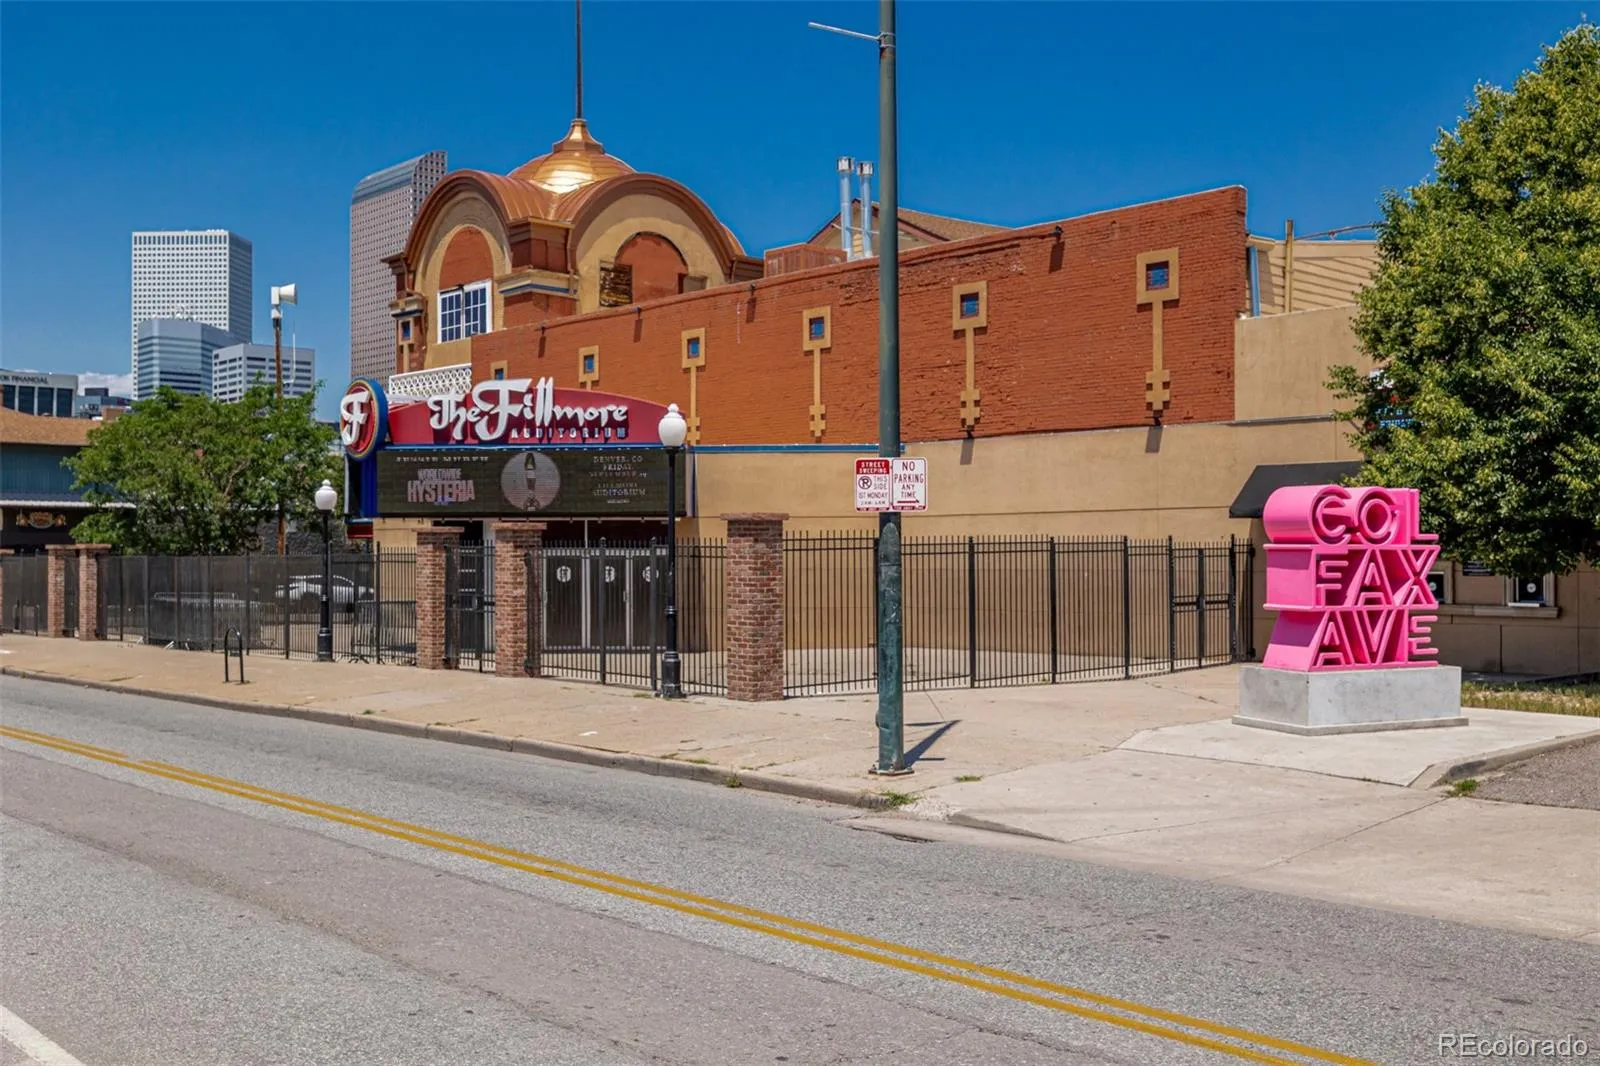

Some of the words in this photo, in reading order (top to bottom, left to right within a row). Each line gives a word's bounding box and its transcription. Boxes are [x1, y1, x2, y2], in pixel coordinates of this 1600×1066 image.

[12, 376, 48, 385] FINANCIAL
[427, 388, 482, 441] The
[472, 376, 628, 441] Fillmore
[340, 390, 370, 447] F
[511, 427, 627, 439] AUDITORIUM
[902, 461, 915, 471] NO
[874, 475, 888, 483] THIS
[894, 473, 924, 484] PARKING
[407, 479, 475, 503] HYSTERIA
[867, 491, 888, 499] MONDAY
[901, 491, 916, 499] TIME
[1311, 484, 1439, 547] COL
[1313, 544, 1441, 609] FAX
[1308, 604, 1439, 672] AVE
